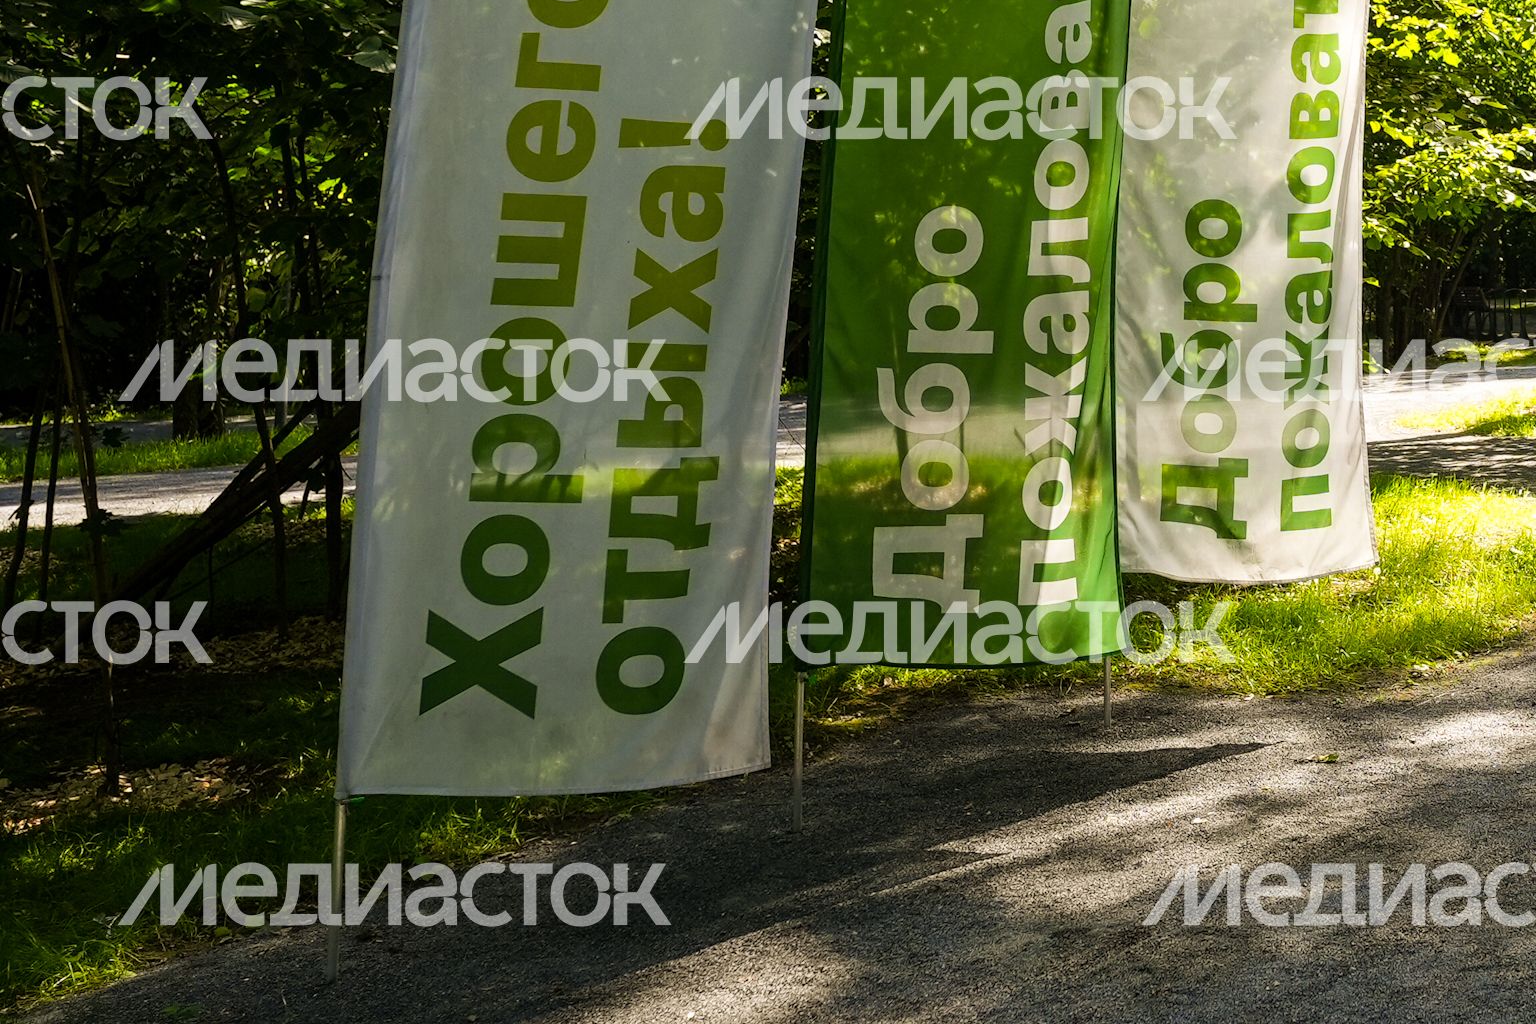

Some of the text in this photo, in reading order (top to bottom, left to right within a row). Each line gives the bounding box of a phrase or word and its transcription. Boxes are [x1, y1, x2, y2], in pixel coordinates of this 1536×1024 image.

[595, 117, 729, 716] отдыха!
[872, 205, 994, 614] Добро
[1160, 198, 1258, 540] Добро
